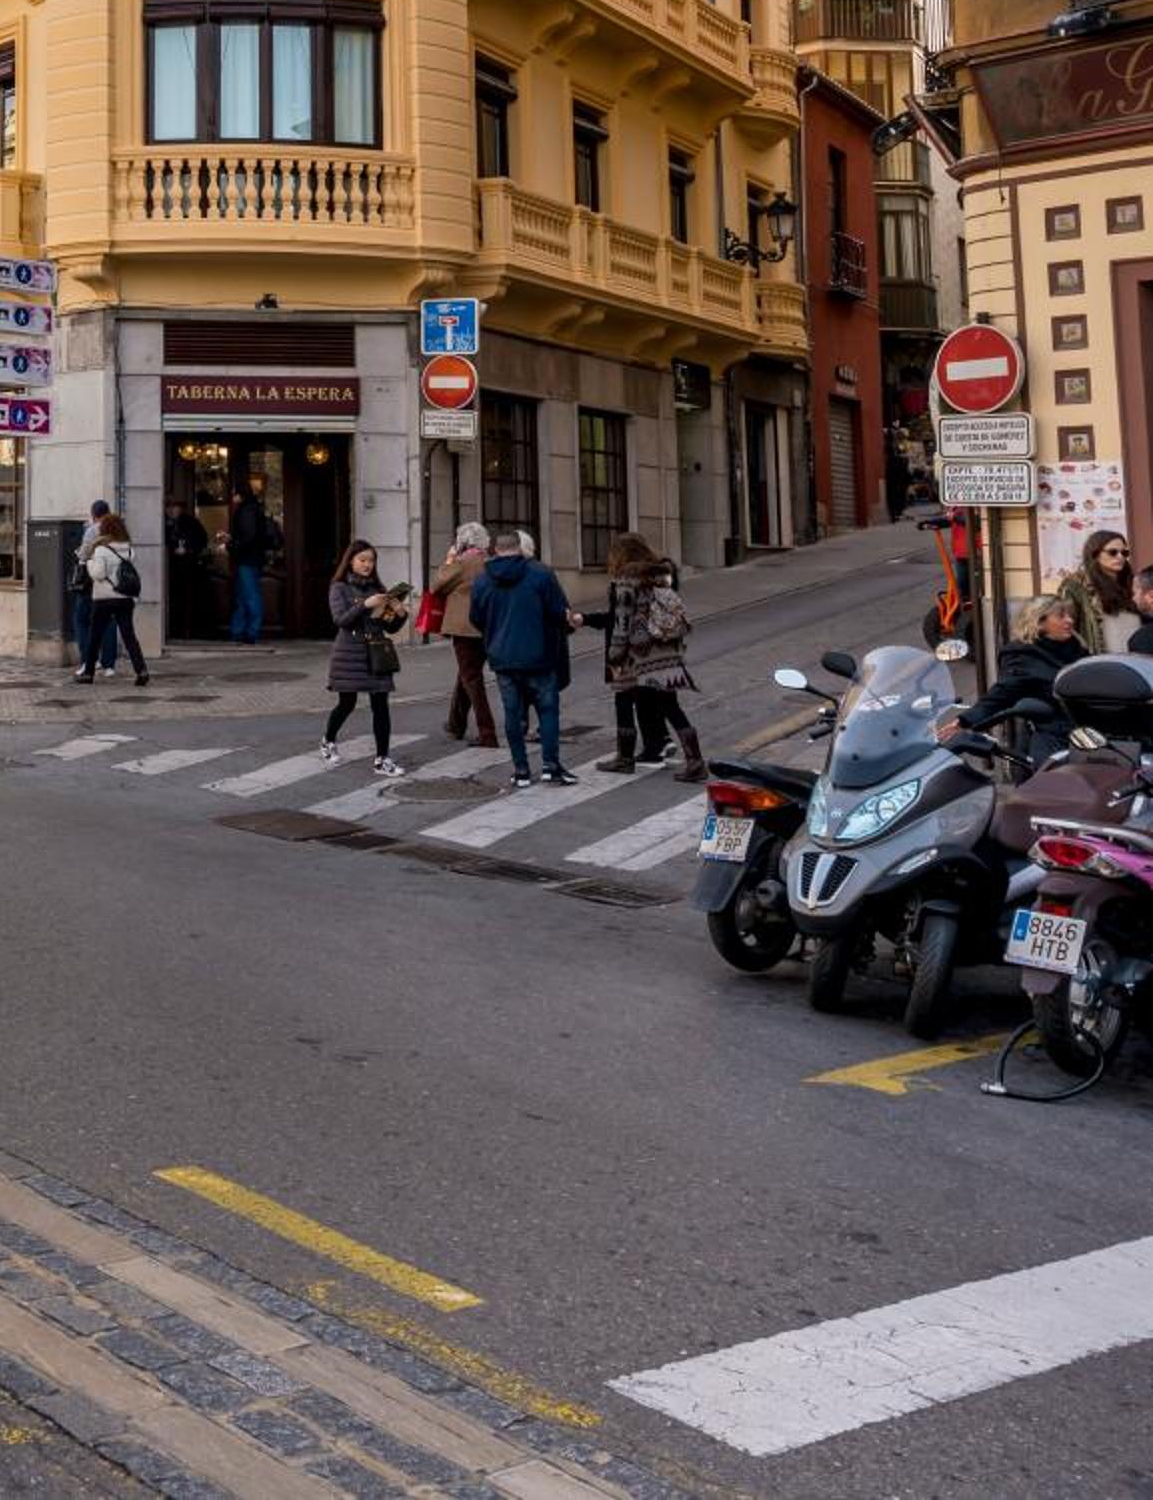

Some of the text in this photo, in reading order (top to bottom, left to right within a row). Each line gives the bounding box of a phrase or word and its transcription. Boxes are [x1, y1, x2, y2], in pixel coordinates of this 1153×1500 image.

[166, 385, 354, 401] TABERNA LA ESPERA
[1029, 917, 1078, 941] 8846
[1030, 937, 1069, 961] HTB
